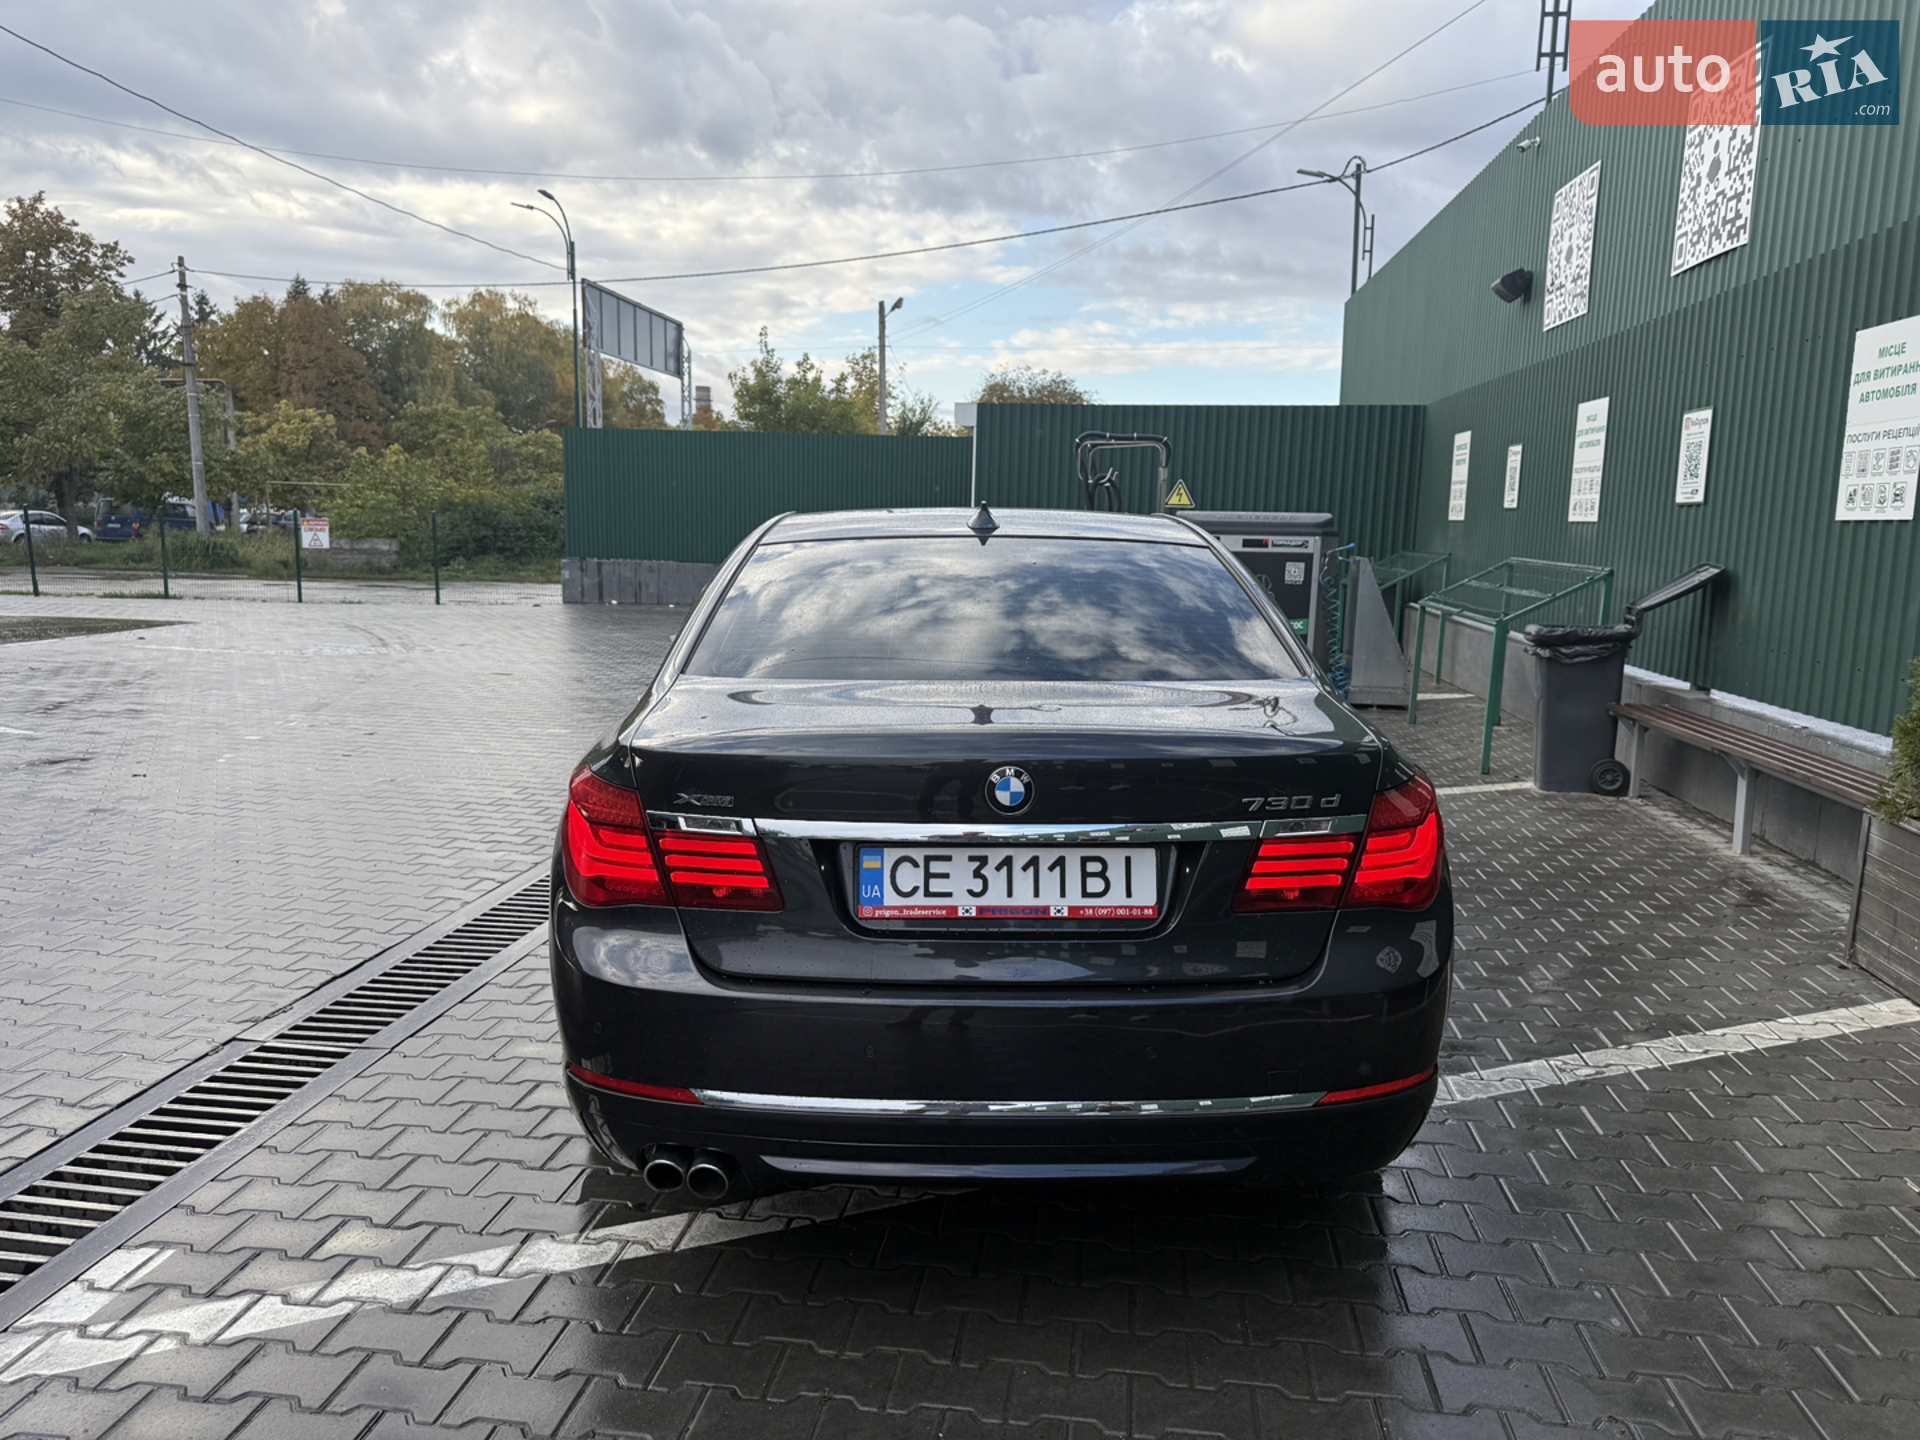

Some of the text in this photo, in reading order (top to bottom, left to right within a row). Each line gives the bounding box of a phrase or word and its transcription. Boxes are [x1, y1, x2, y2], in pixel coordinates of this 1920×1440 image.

[1877, 342, 1907, 359] МІСЦЕ
[1853, 370, 1871, 387] ДЛЯ
[1859, 383, 1918, 404] АВТОМОБІЛЯ
[1846, 430, 1881, 445] ПОСЛУГИ
[989, 767, 1031, 785] BMW
[1241, 793, 1341, 812] 730 d
[862, 885, 881, 898] UA
[1095, 907, 1115, 917] (097)
